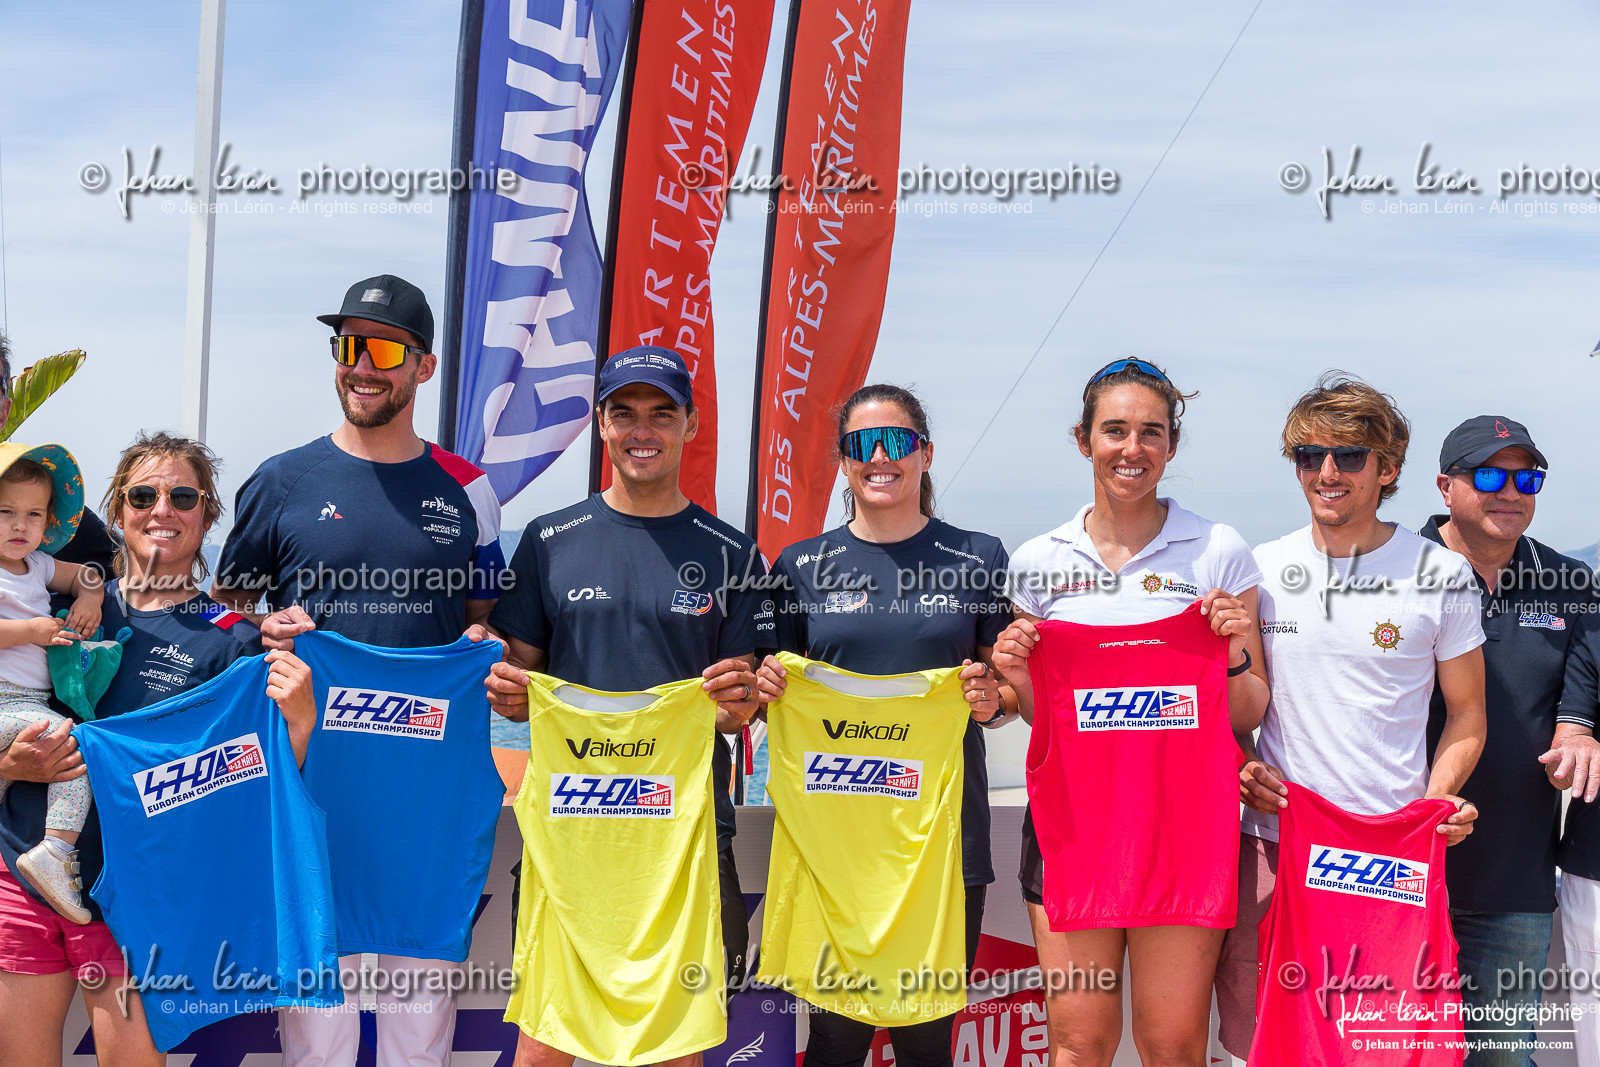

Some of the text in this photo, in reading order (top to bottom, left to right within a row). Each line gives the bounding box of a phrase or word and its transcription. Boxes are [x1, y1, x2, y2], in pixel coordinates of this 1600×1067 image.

[638, 0, 706, 347] ARTEMEN
[772, 433, 793, 525] DES
[672, 590, 712, 610] ESP
[1164, 584, 1198, 596] PORTUGAL
[328, 690, 408, 723] 470
[1080, 691, 1156, 720] 470
[1174, 704, 1187, 716] MAY
[326, 720, 440, 737] EUROPEAN CHAMPIONSHIP
[424, 715, 436, 726] MAY
[822, 718, 910, 741] Vaikobi
[1080, 719, 1195, 728] EUROPEAN CHAMPIONSHIP
[566, 738, 656, 760] Vaikobi
[240, 752, 254, 768] MAY
[807, 754, 884, 784] 470
[144, 750, 218, 801] 470
[898, 777, 912, 788] MAY
[148, 766, 264, 814] EUROPEAN CHAMPIONSHIP
[554, 776, 634, 806] 470
[652, 793, 664, 804] MAY
[806, 784, 918, 798] EUROPEAN CHAMPIONSHIP
[602, 808, 671, 816] CHAMPIONSHIP
[1312, 849, 1394, 886] 470
[1308, 878, 1424, 903] EUROPEAN CHAMPIONSHIP
[1406, 880, 1419, 892] MAY
